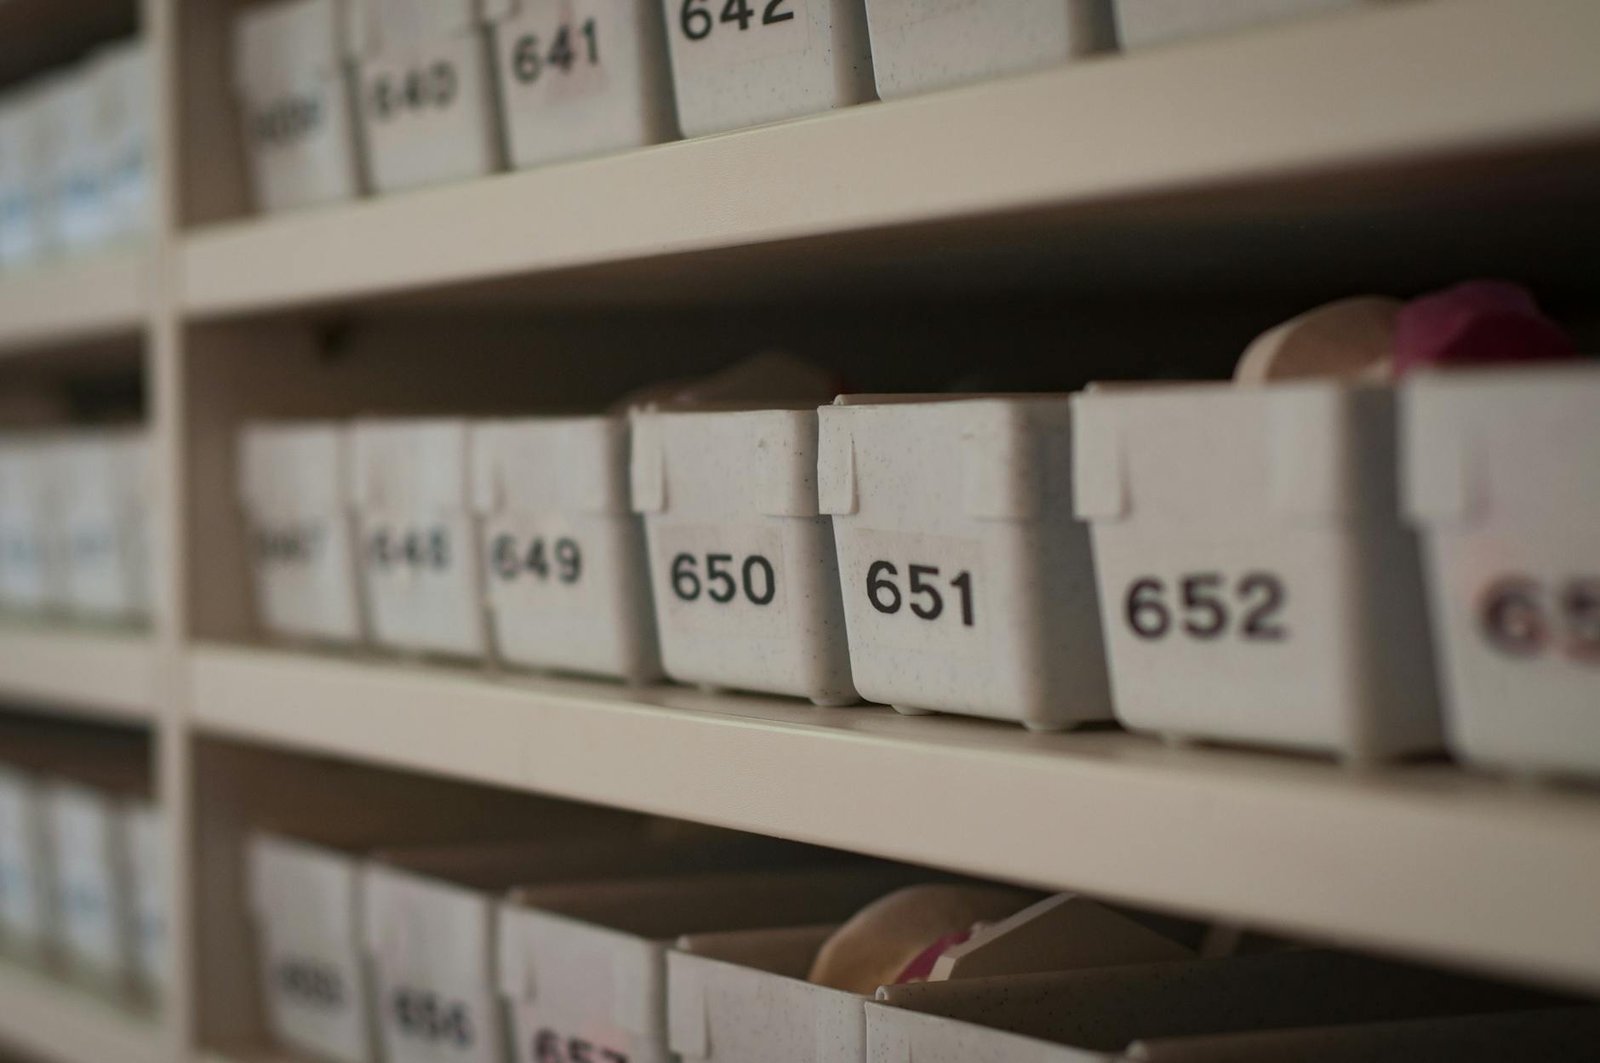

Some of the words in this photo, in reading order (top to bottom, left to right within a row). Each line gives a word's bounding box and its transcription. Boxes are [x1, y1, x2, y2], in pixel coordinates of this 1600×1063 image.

[679, 0, 794, 41] 642
[512, 19, 598, 84] 641
[492, 535, 582, 585] 649
[670, 552, 776, 605] 650
[866, 560, 976, 627] 651
[1126, 572, 1288, 642] 652
